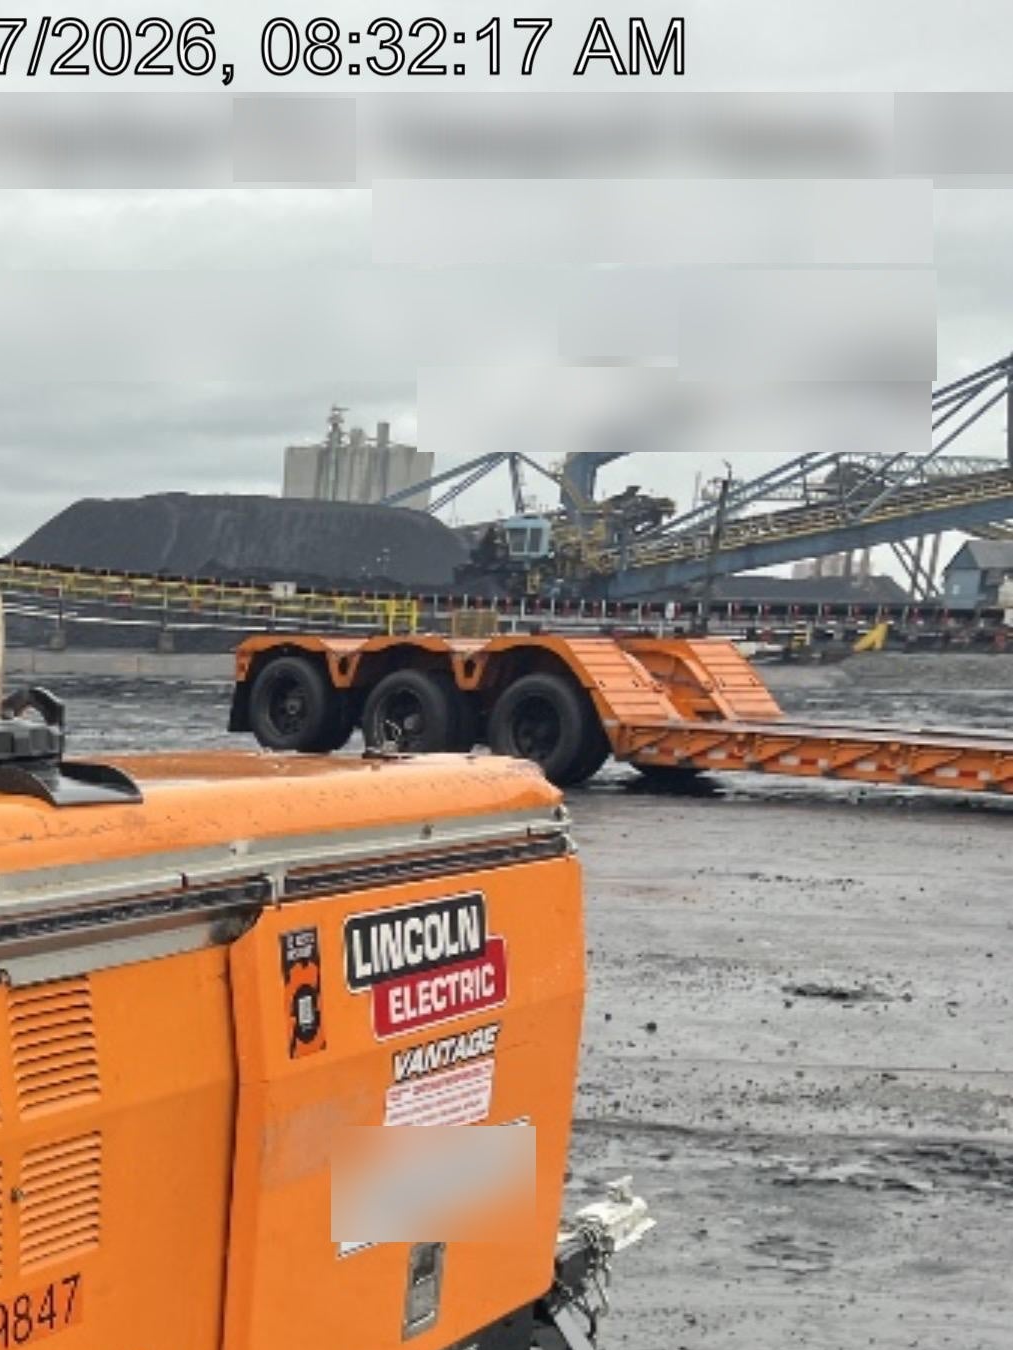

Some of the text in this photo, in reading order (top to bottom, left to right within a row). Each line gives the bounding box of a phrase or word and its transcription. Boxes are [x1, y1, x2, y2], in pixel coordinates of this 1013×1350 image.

[351, 905, 480, 979] LINCOLN
[388, 965, 497, 1025] ELECTRIC
[393, 1024, 499, 1082] VANTAGE
